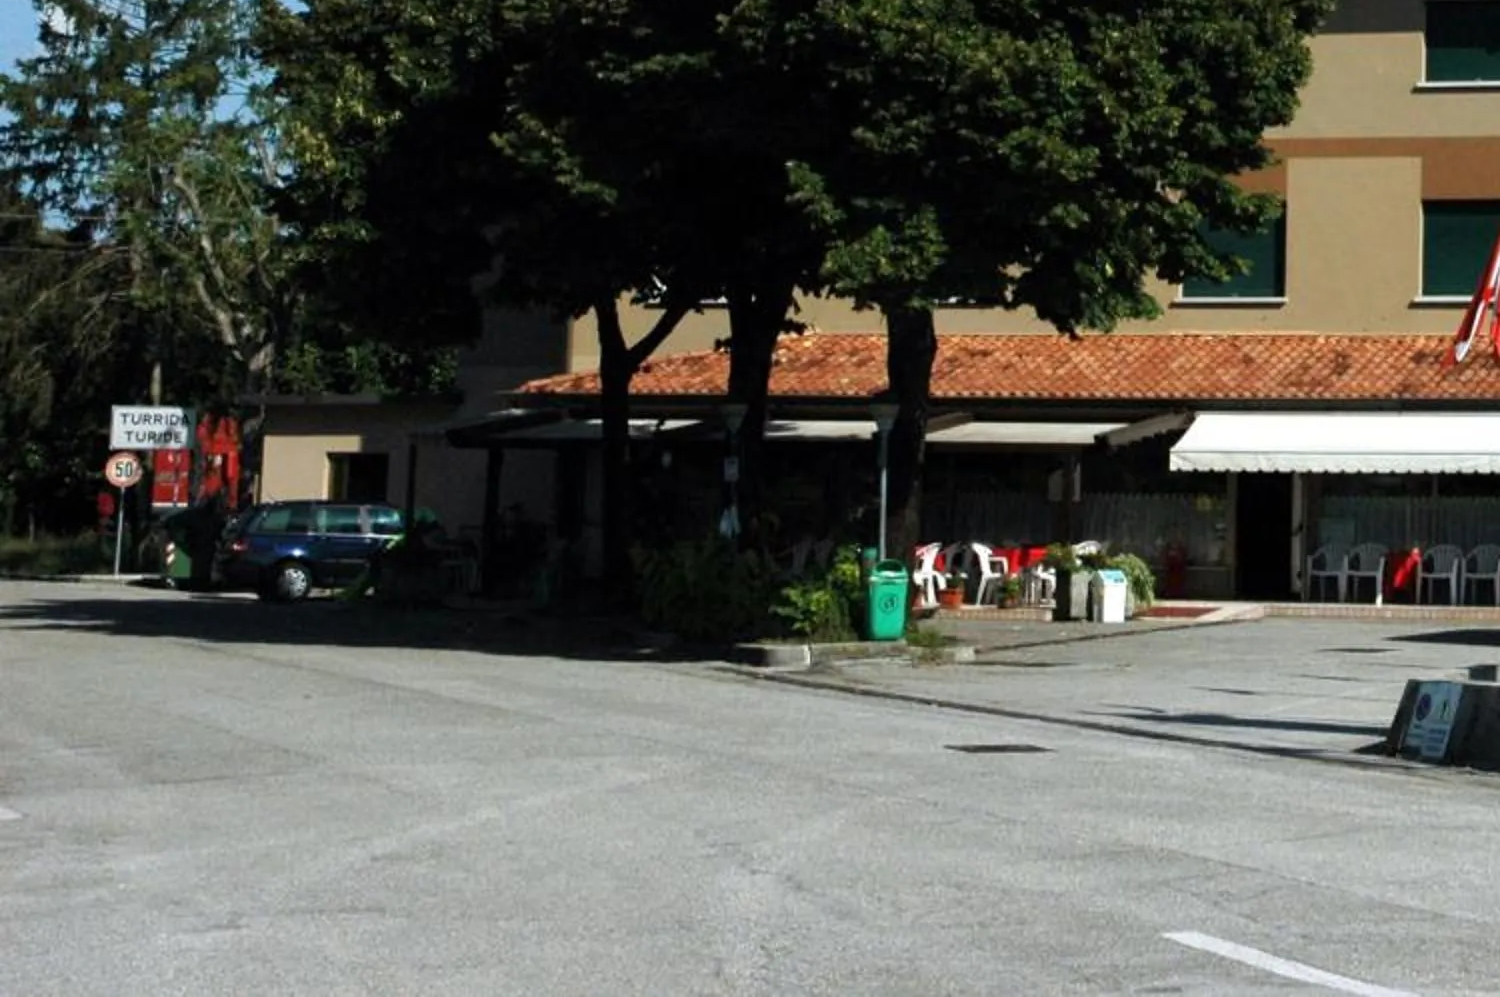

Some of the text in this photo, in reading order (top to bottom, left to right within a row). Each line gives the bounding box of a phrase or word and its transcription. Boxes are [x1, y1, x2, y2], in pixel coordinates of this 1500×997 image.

[120, 413, 190, 426] TURRIDA
[124, 430, 182, 444] TURIDE
[115, 461, 133, 478] 50
